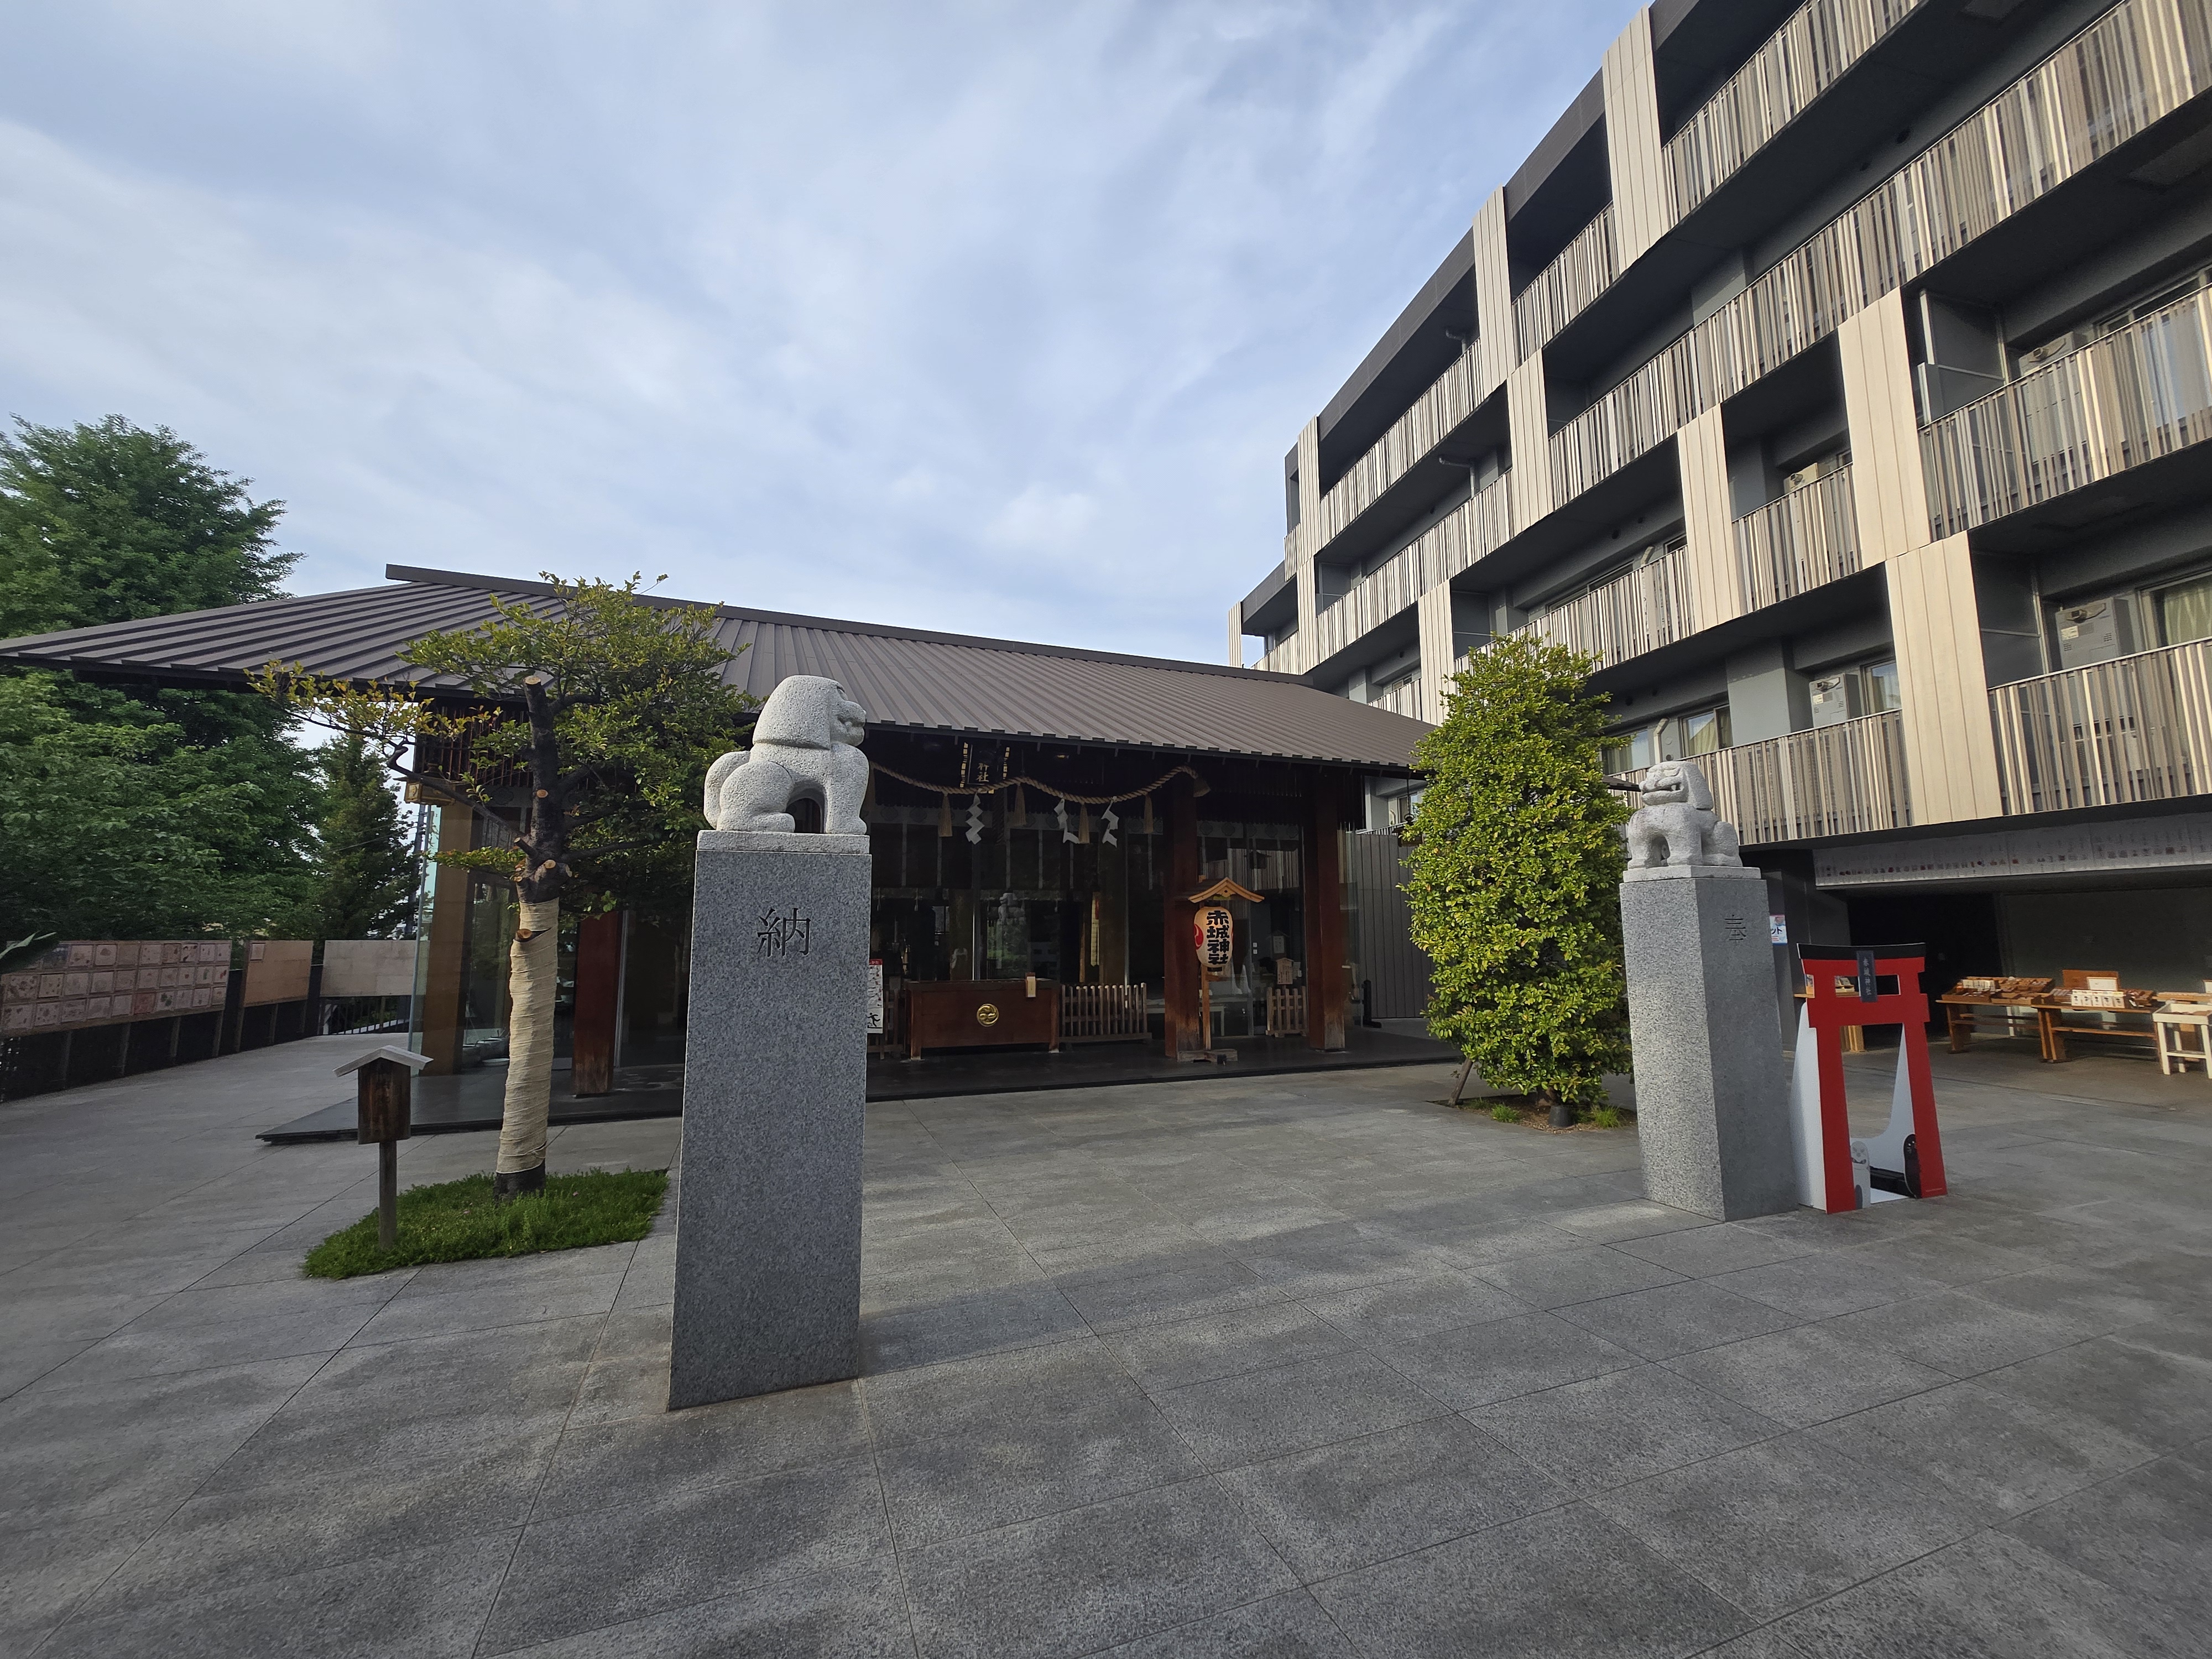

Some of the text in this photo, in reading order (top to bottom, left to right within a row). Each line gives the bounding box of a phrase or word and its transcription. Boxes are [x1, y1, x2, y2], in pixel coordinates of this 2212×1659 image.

[757, 908, 811, 957] 納
[1206, 910, 1230, 964] 赤城神社
[1725, 914, 1746, 946] 奉
